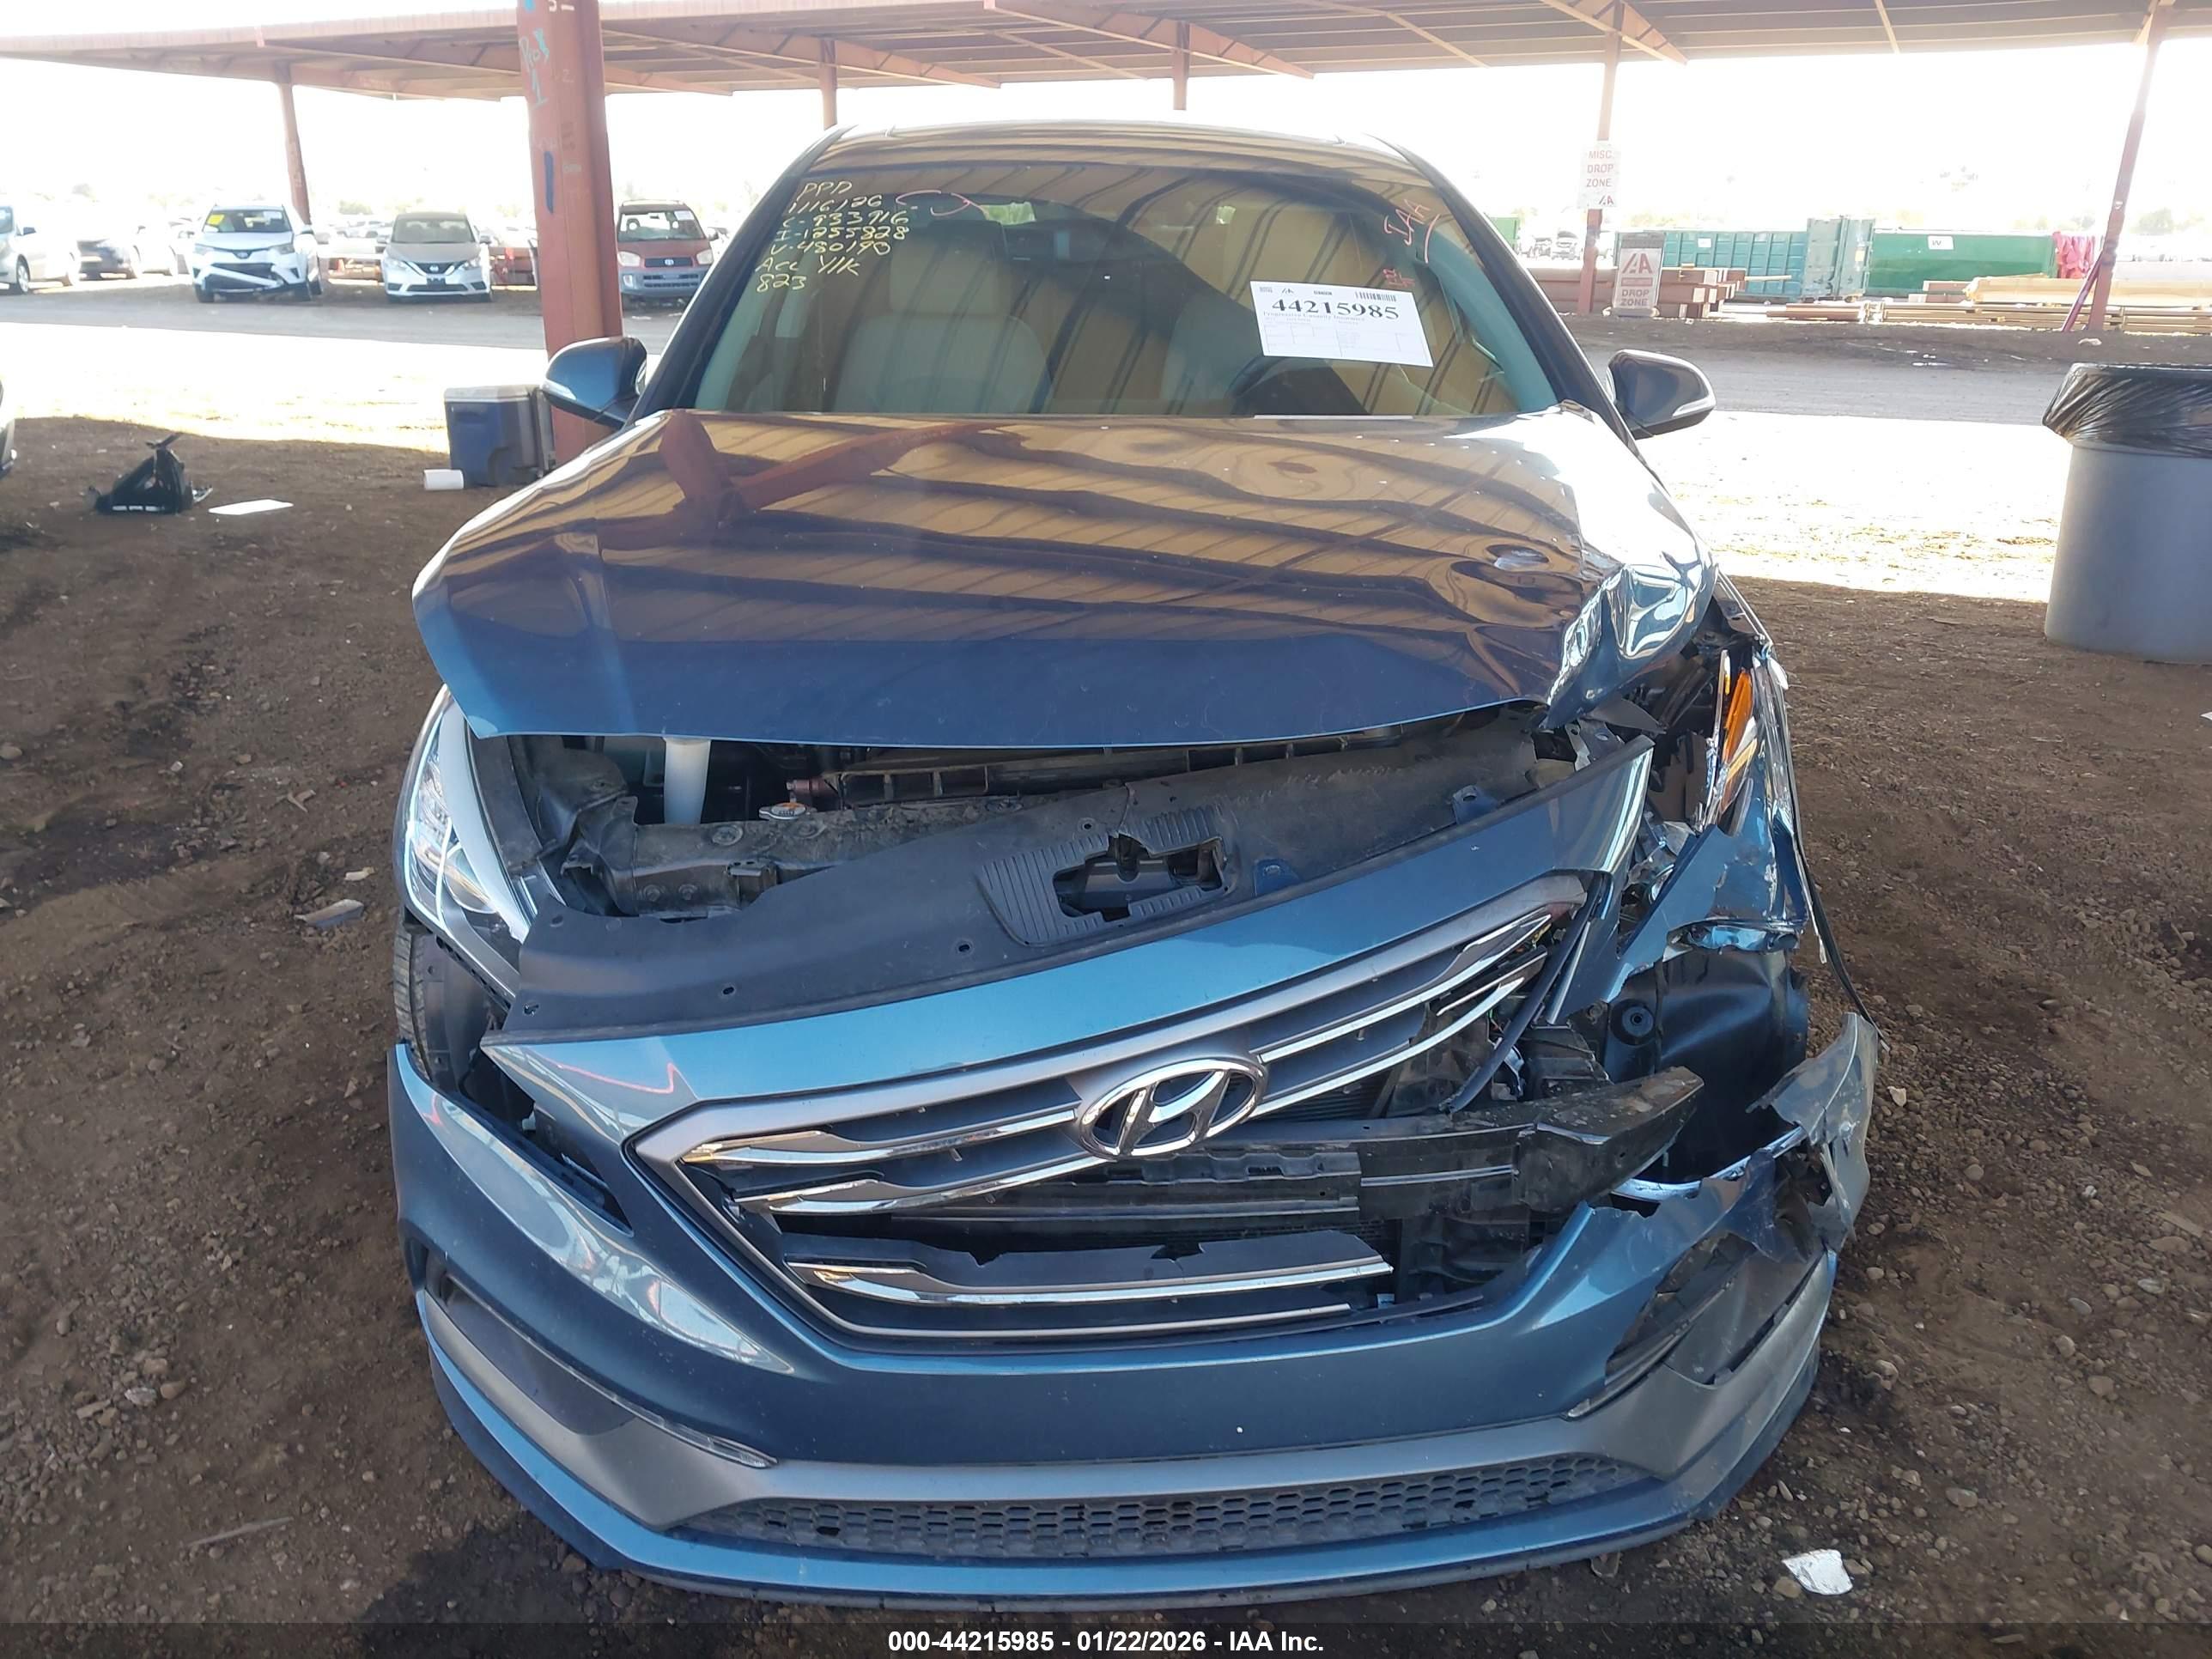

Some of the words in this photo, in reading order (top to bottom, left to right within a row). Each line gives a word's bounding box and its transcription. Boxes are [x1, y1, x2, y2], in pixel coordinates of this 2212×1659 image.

[1589, 150, 1612, 159] MISC
[1587, 164, 1614, 173] DROP
[1586, 178, 1612, 187] ZONE
[796, 180, 853, 201] PPD
[757, 274, 807, 292] 823
[1621, 289, 1650, 297] DROP
[1620, 298, 1649, 307] ZONE
[1272, 299, 1400, 320] 44215985
